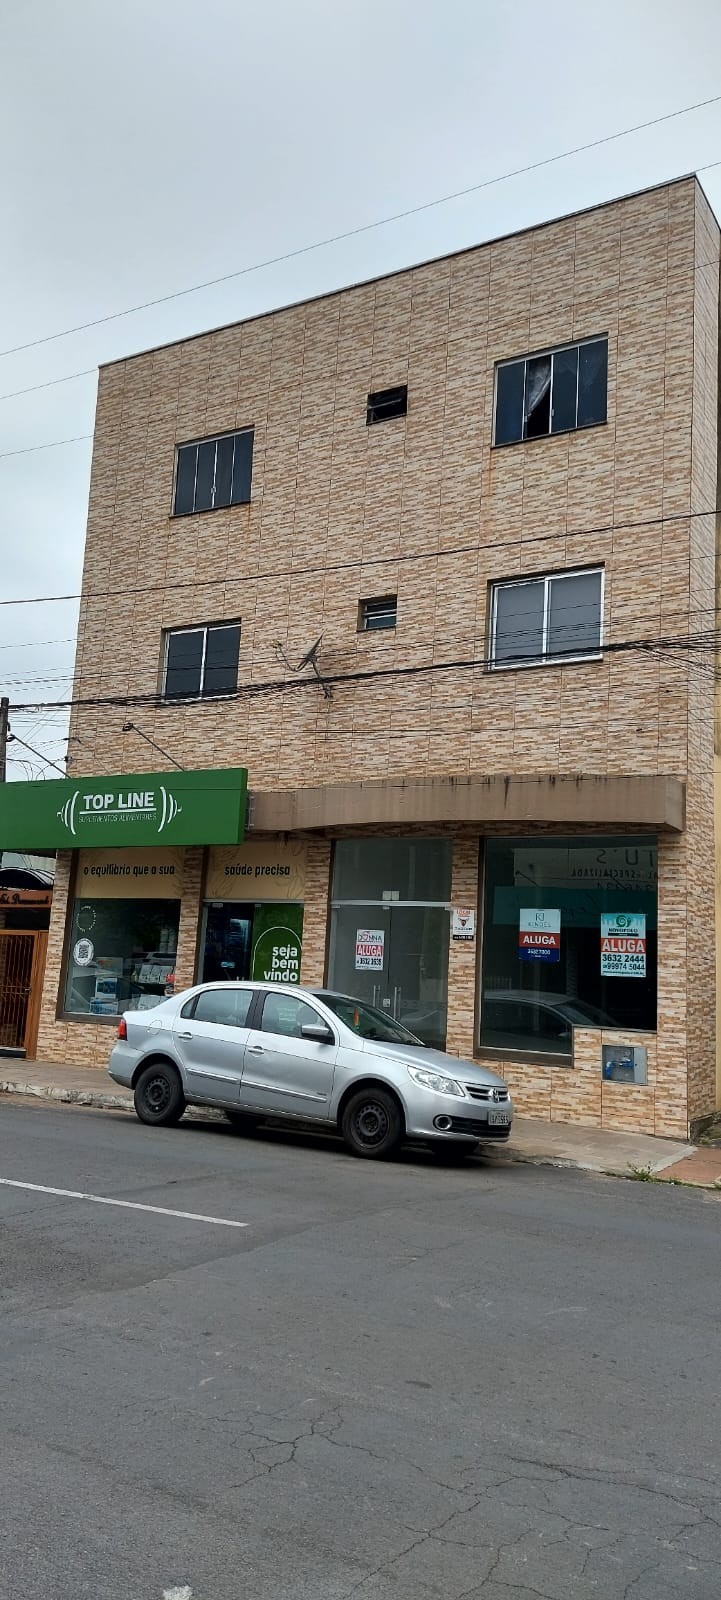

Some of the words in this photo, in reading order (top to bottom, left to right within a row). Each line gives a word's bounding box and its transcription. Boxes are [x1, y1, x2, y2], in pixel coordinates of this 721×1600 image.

[83, 794, 114, 810] TOP
[117, 791, 155, 809] LINE
[83, 866, 89, 875] o
[132, 865, 149, 877] que
[151, 865, 157, 875] a
[159, 864, 175, 875] sua
[224, 863, 253, 876] saúde
[254, 863, 291, 878] precisa
[523, 935, 556, 945] ALUGA
[602, 938, 646, 953] ALUGA
[272, 944, 298, 960] seja
[357, 945, 383, 957] ALUGA
[271, 956, 299, 970] bem
[602, 954, 622, 962] 3632
[624, 955, 645, 963] 2444
[263, 968, 298, 982] vindo
